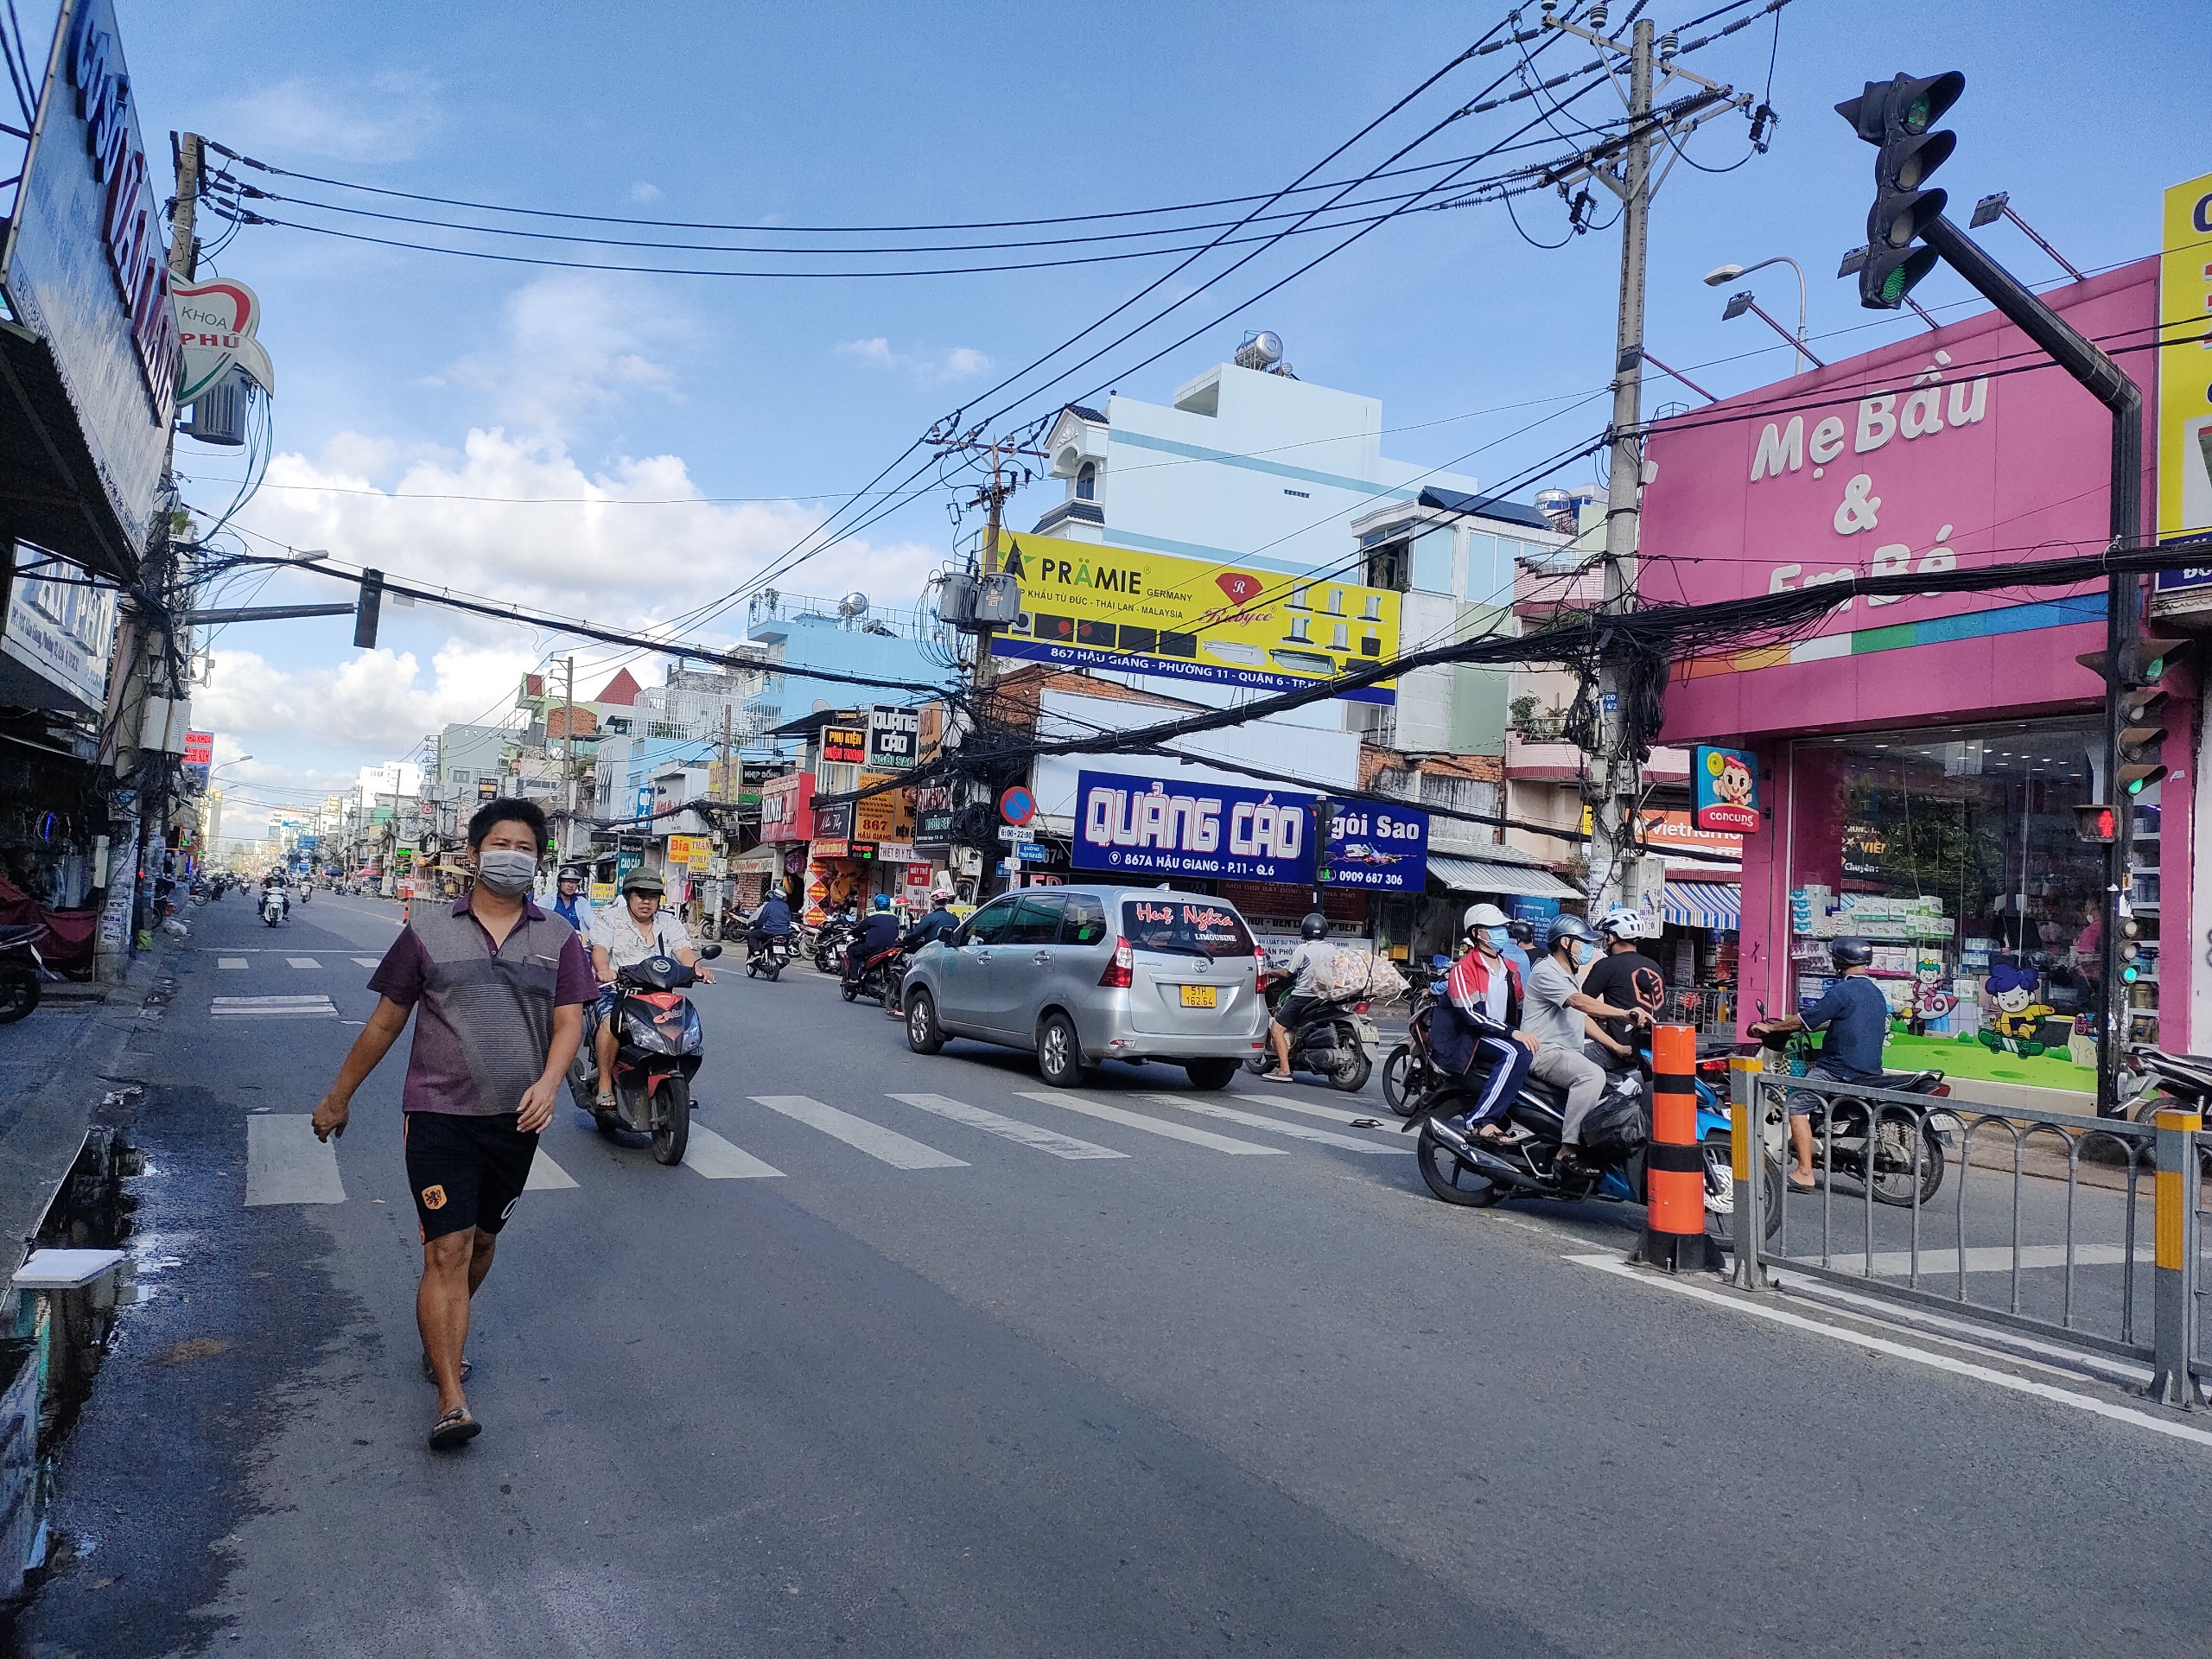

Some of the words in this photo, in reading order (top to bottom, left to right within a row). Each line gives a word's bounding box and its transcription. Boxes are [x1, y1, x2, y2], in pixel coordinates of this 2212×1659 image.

[181, 306, 227, 330] KHOA
[181, 333, 240, 348] PHÚ
[1750, 415, 1844, 480] Mẹ
[1854, 350, 1987, 454] Bầu
[1834, 474, 1881, 536] &
[1041, 557, 1141, 595] PRÄMIE
[1147, 588, 1193, 602] GERMANY
[1027, 588, 1053, 601] KHẨU
[1055, 589, 1067, 602] TỪ
[1069, 591, 1088, 605] ĐỨC
[1096, 598, 1116, 609] THÁI
[1117, 602, 1135, 613] LAN
[1141, 606, 1184, 619] MALAYSIA
[1050, 647, 1074, 659] 867
[1077, 650, 1105, 664] HẬU
[1108, 654, 1149, 669] GIANG
[1159, 660, 1212, 677] PHƯỜNG
[1216, 668, 1229, 680] 11
[1238, 671, 1274, 687] QUẬN
[1276, 675, 1285, 686] 6
[874, 709, 918, 732] QUẢNG
[829, 731, 844, 745] PHỤ
[845, 732, 862, 747] KIỆN
[880, 730, 908, 753] CÁO
[871, 753, 895, 766] NGÔI
[896, 755, 915, 767] SAO
[862, 819, 888, 830] 867
[1085, 781, 1222, 853] QUẢNG
[1230, 793, 1304, 859] CÁO
[1326, 812, 1368, 840] gôi
[1376, 815, 1420, 840] Sao
[1709, 811, 1754, 827] concung
[857, 830, 871, 840] HẬU
[873, 832, 892, 841] GIANG
[1001, 829, 1014, 837] 6:00
[1017, 830, 1033, 839] 22:00
[670, 839, 689, 852] Bia
[620, 857, 631, 868] CAO
[1037, 848, 1064, 864] 67A
[1125, 854, 1153, 867] 867A
[1156, 855, 1179, 872] HẬU
[1183, 857, 1219, 871] GIANG
[1228, 861, 1247, 874] P.11
[1256, 863, 1274, 876] Q.6
[1339, 870, 1363, 882] 0909
[1365, 872, 1382, 884] 687
[1385, 874, 1403, 885] 306
[1136, 902, 1174, 925] Huệ
[1183, 905, 1234, 931] Nghĩa
[1194, 933, 1237, 942] LIMOUSINE
[1191, 987, 1206, 995] 51H
[1186, 996, 1213, 1006] 162.64
